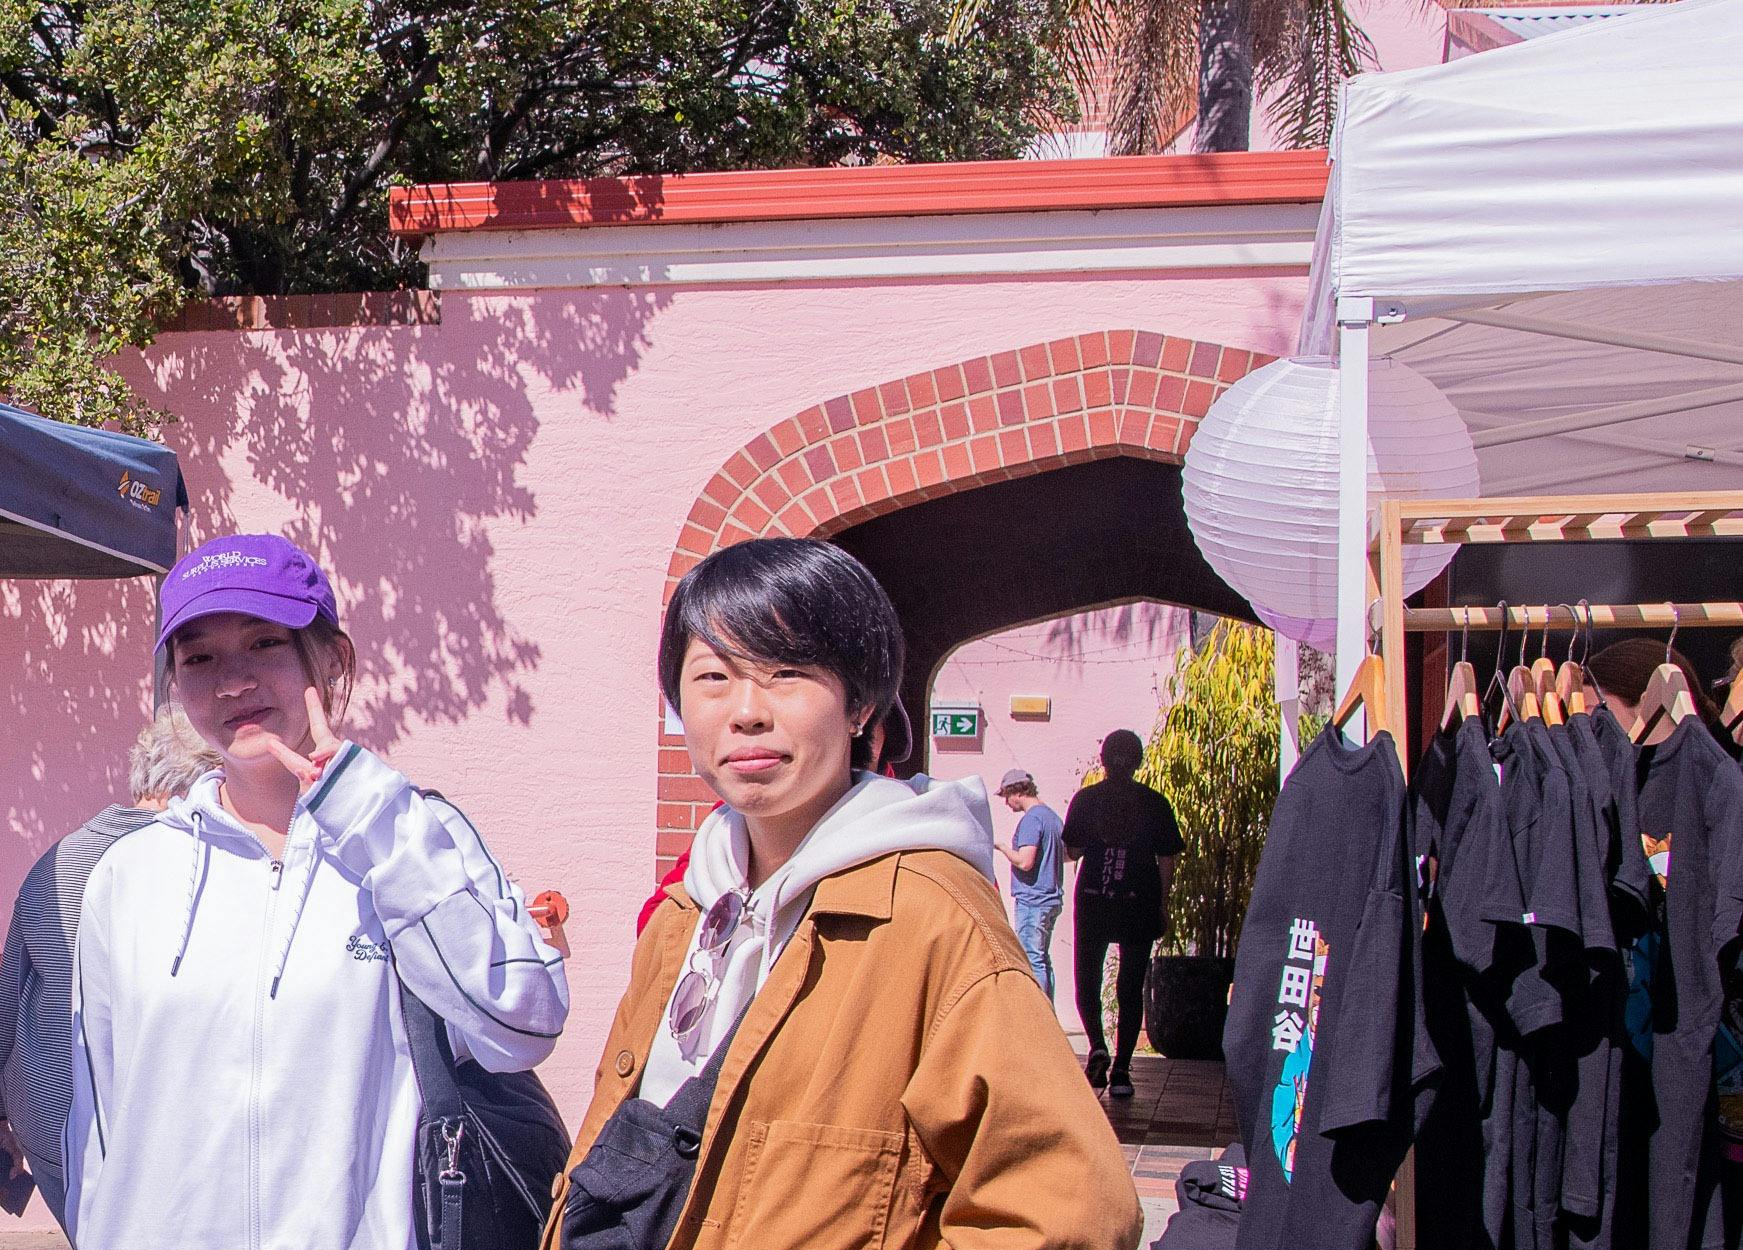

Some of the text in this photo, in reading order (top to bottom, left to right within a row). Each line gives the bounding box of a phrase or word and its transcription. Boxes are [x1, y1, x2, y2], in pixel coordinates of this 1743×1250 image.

[202, 551, 242, 563] WORLD
[346, 935, 378, 953] Young
[1272, 918, 1319, 1054] 世田谷
